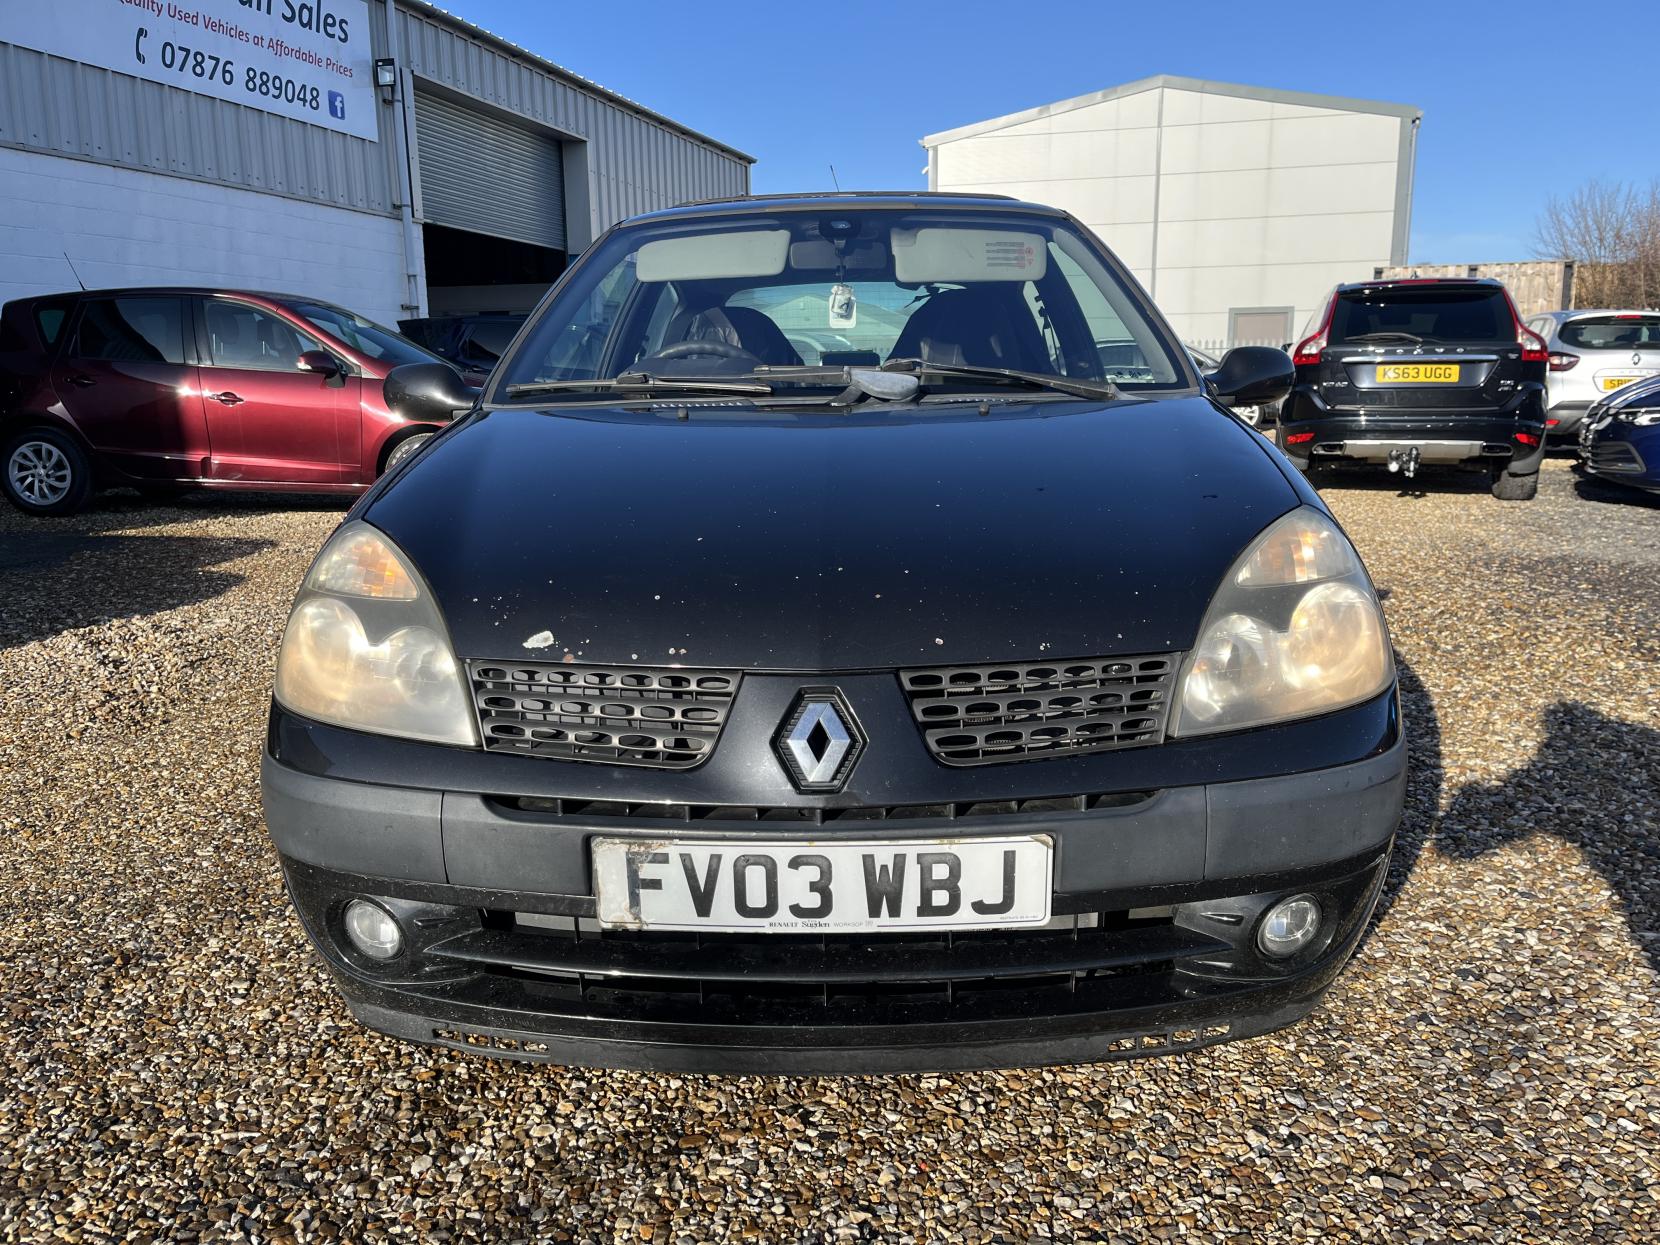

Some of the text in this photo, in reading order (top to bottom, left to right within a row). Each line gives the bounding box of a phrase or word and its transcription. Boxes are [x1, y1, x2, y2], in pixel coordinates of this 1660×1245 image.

[167, 3, 199, 26] Used
[202, 15, 250, 43] Vehicles
[252, 34, 265, 48] at
[267, 37, 323, 68] Affordable
[325, 57, 353, 78] Prices
[281, 0, 349, 43] Sales
[161, 41, 320, 111] 07876 889048
[1382, 367, 1452, 380] KS63 UGG
[626, 849, 1016, 919] FV03 WBJ
